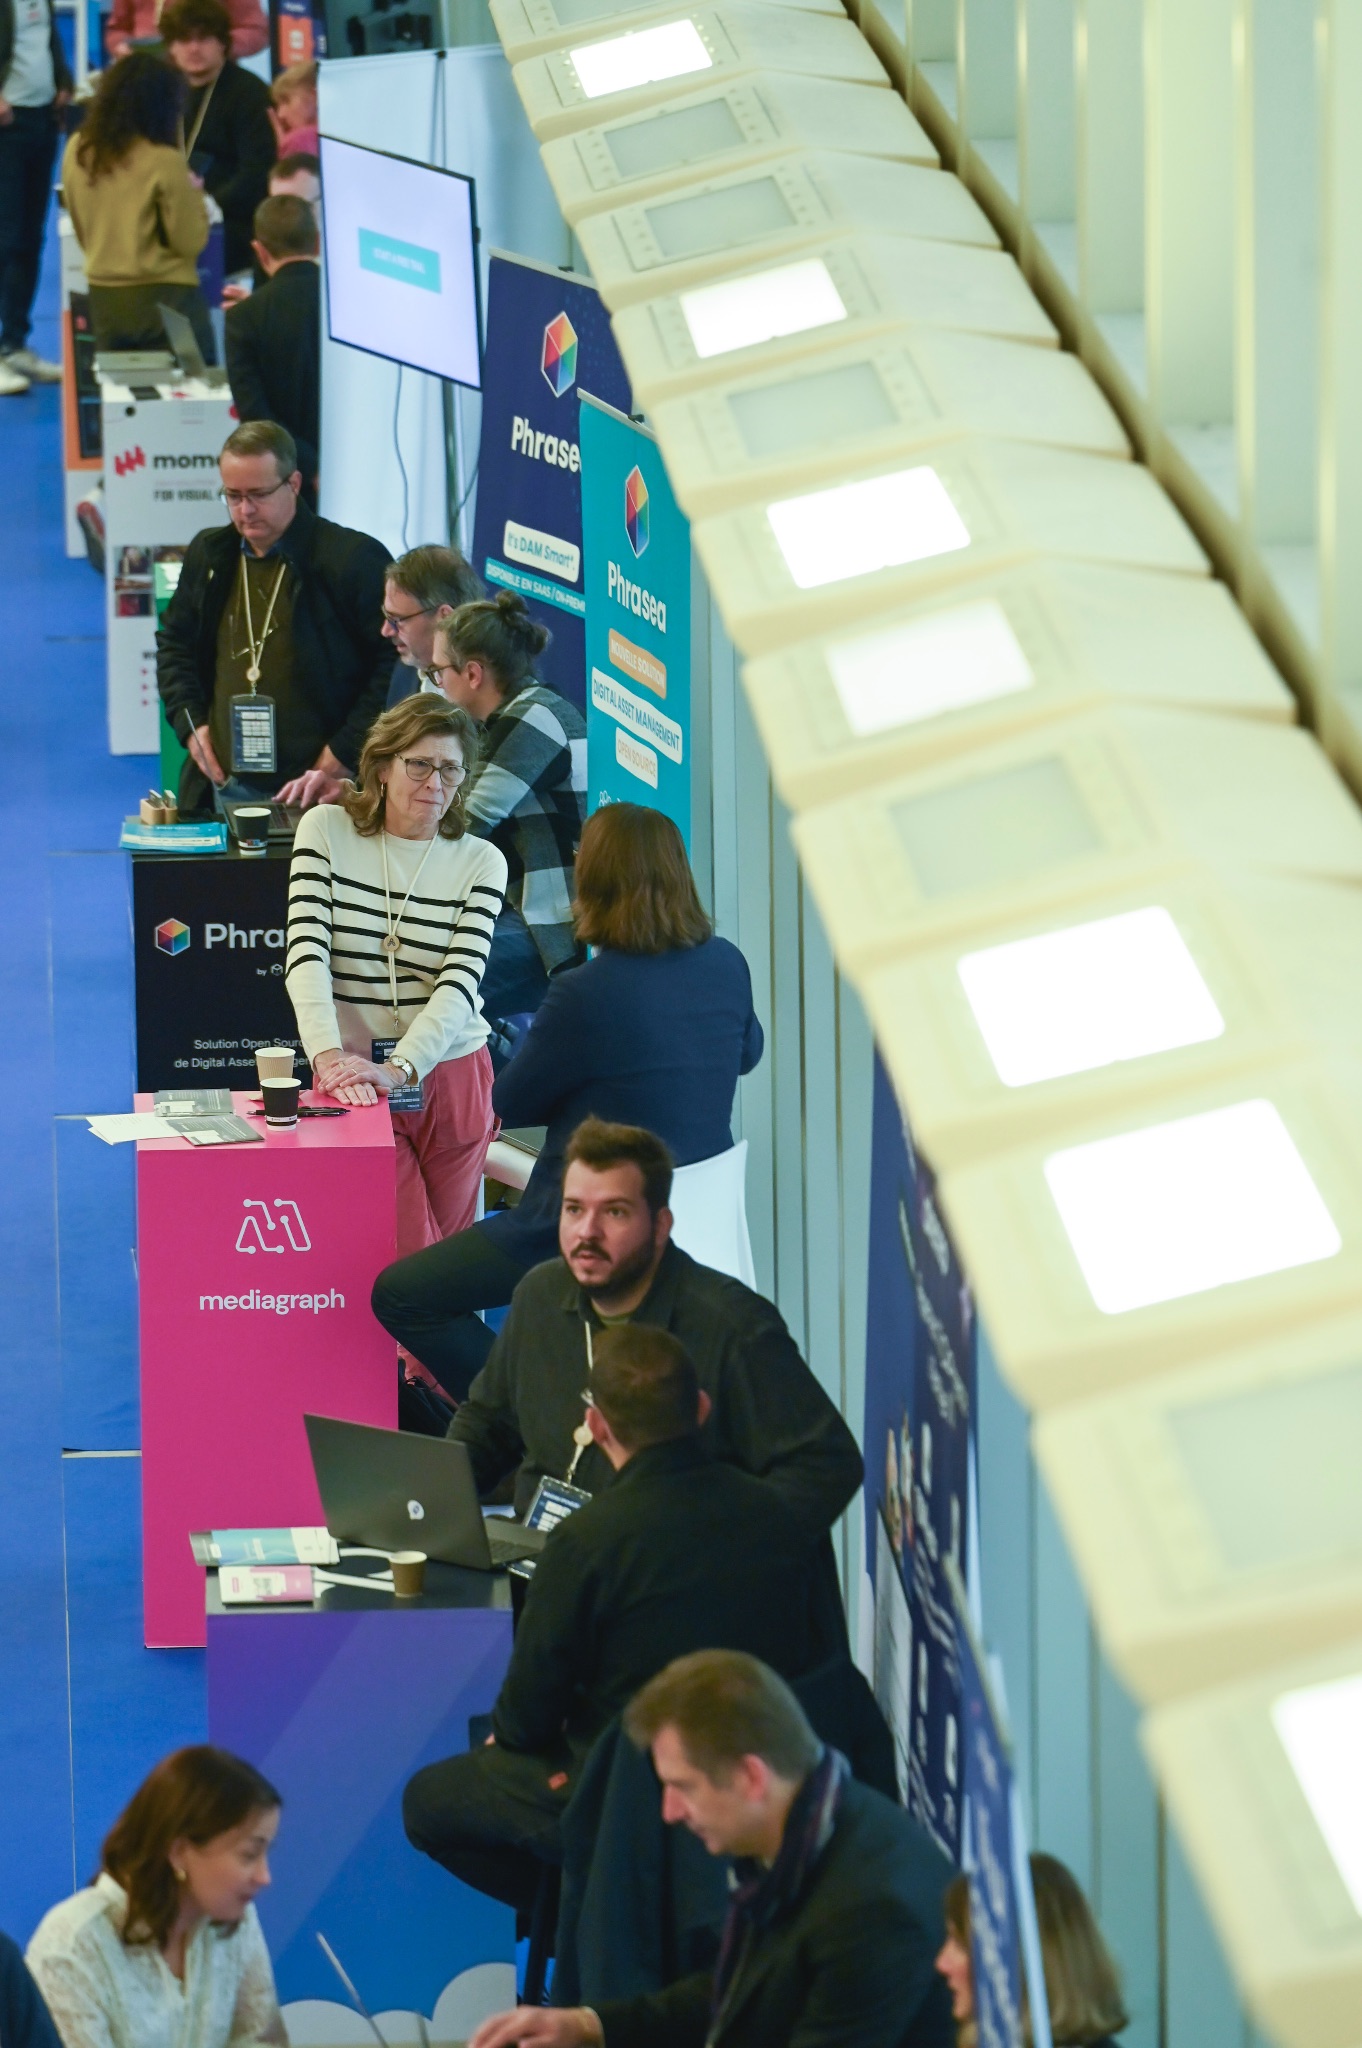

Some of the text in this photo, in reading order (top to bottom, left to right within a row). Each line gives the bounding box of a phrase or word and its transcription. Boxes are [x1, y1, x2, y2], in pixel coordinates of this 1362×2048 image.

[520, 537, 543, 558] DAM
[521, 578, 533, 592] EN
[607, 560, 667, 634] Phrasea
[593, 679, 680, 751] DIGITAL ASSET MANAGEMENT
[205, 923, 287, 949] Phra
[256, 967, 268, 976] by
[193, 1037, 303, 1051] Solution Open Sourc
[174, 1056, 257, 1070] de Digital Asse
[199, 1287, 346, 1316] mediagraph
